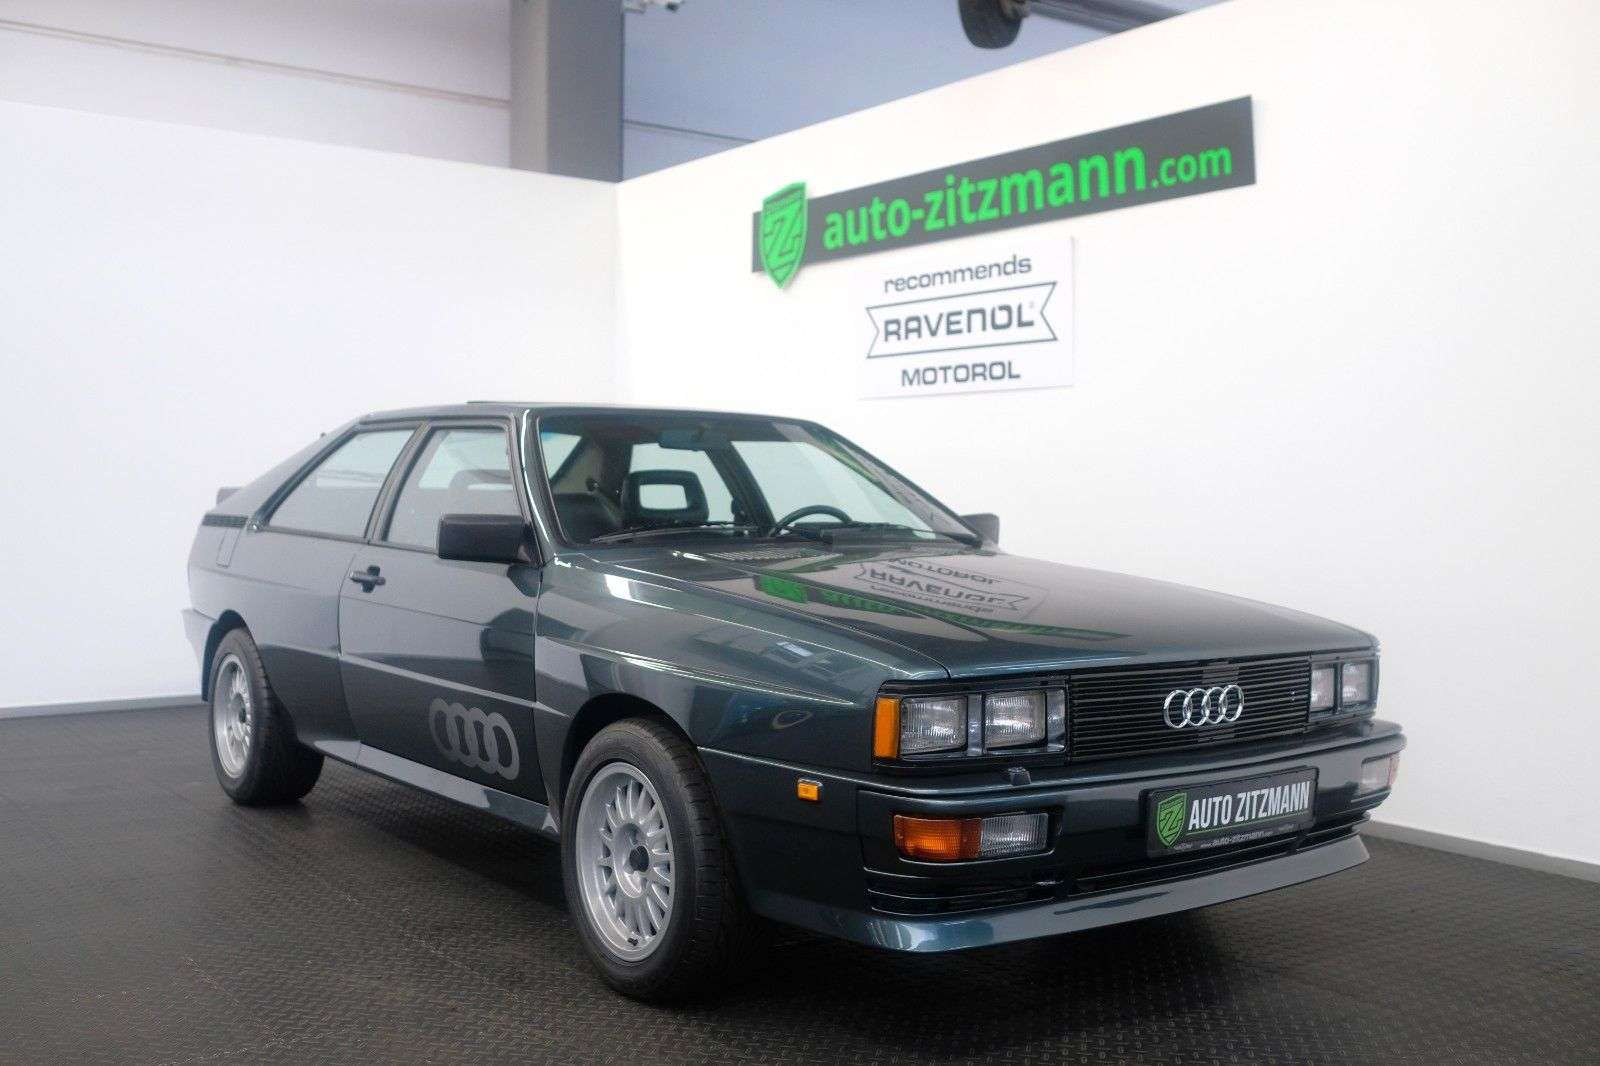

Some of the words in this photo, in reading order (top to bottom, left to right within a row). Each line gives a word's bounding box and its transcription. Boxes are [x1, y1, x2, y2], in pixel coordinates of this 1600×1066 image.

[822, 145, 1233, 251] auto-zitzmann.com
[884, 254, 1033, 294] recommends
[884, 302, 1035, 342] RAVENOL
[901, 360, 1021, 387] MOTOROL
[1188, 794, 1233, 830] AUTO
[1234, 781, 1311, 822] ZITZMANN
